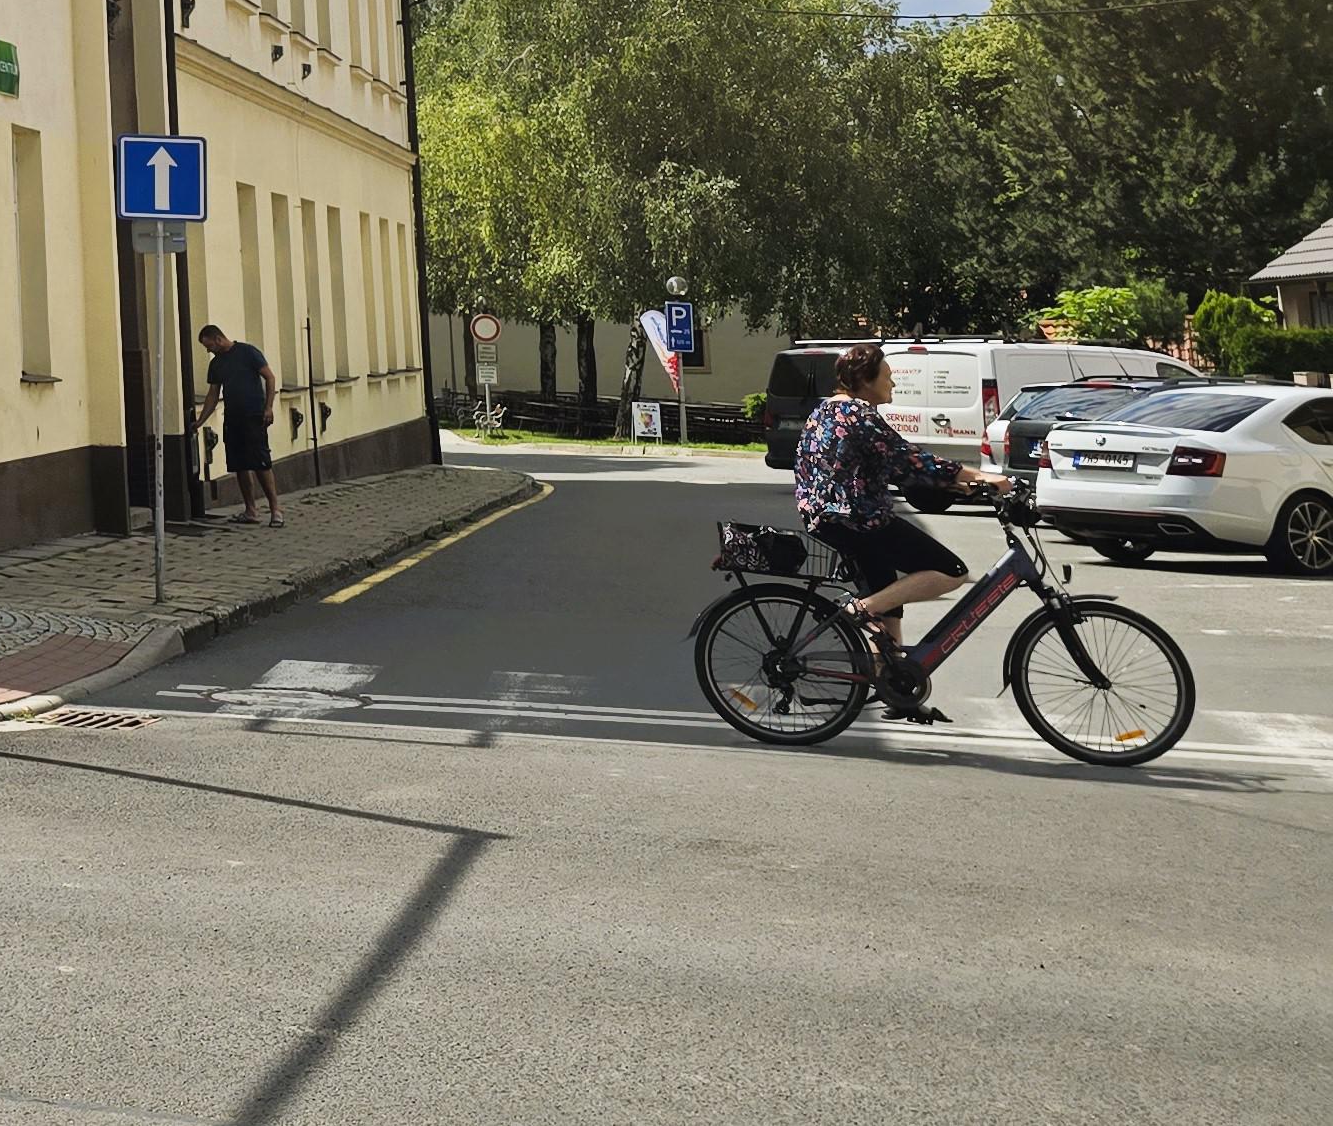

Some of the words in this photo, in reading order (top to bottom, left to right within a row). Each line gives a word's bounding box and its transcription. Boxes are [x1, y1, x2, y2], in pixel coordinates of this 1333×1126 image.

[671, 306, 687, 327] P
[885, 413, 921, 423] SERVISNÍ
[891, 424, 919, 433] OZIDLO
